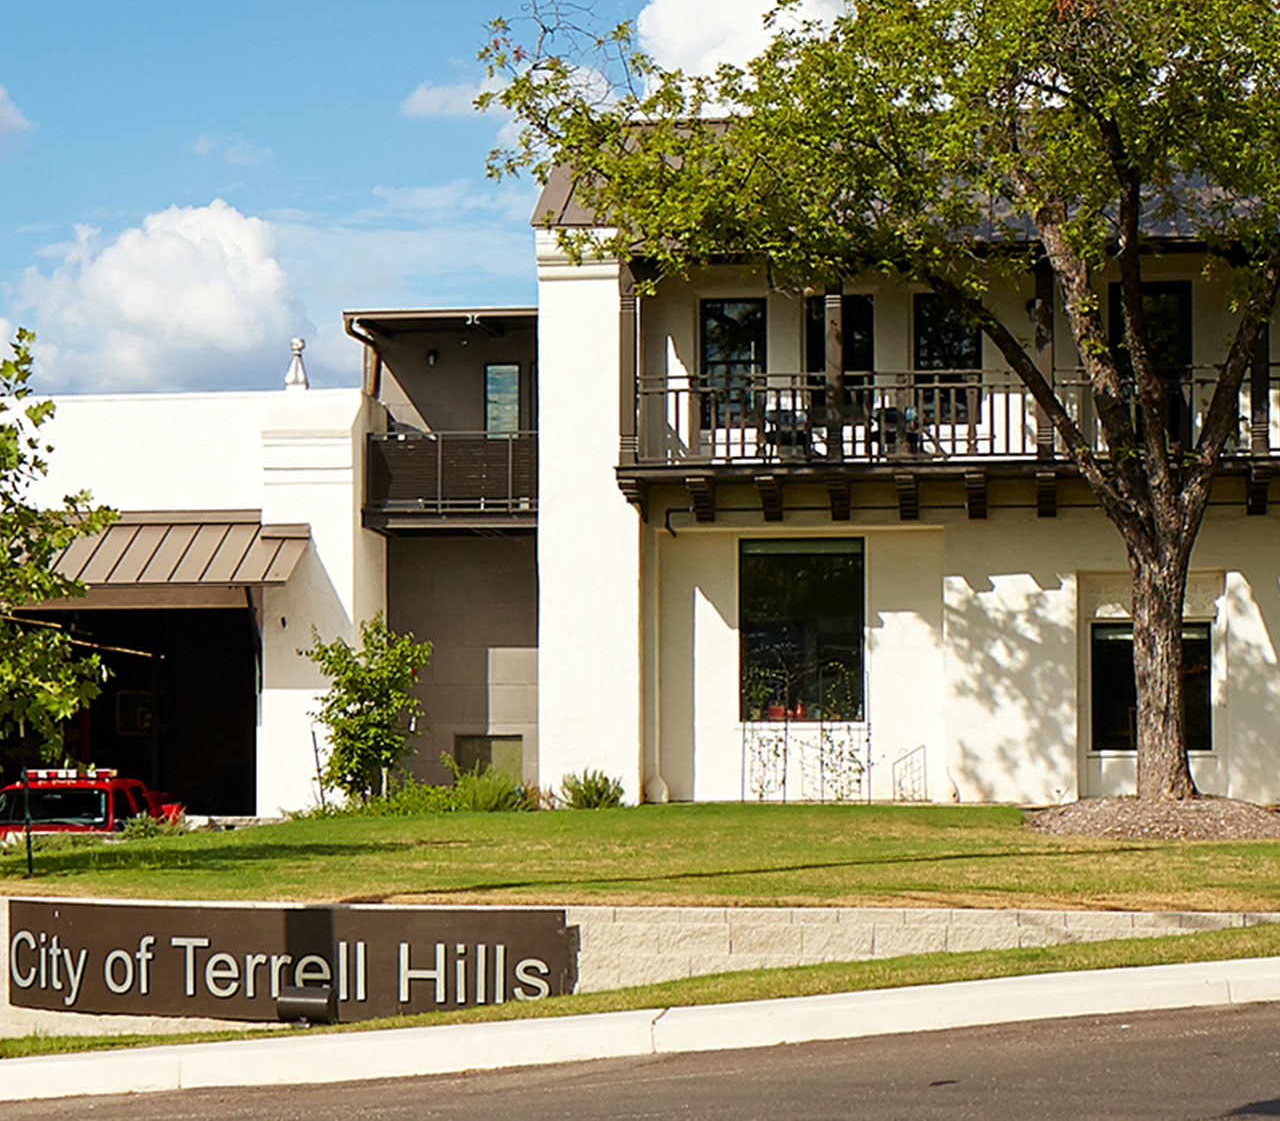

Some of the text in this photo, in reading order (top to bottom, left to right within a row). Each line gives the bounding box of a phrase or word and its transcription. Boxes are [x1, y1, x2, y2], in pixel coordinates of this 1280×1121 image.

[10, 930, 551, 1006] City of Terrell Hills
